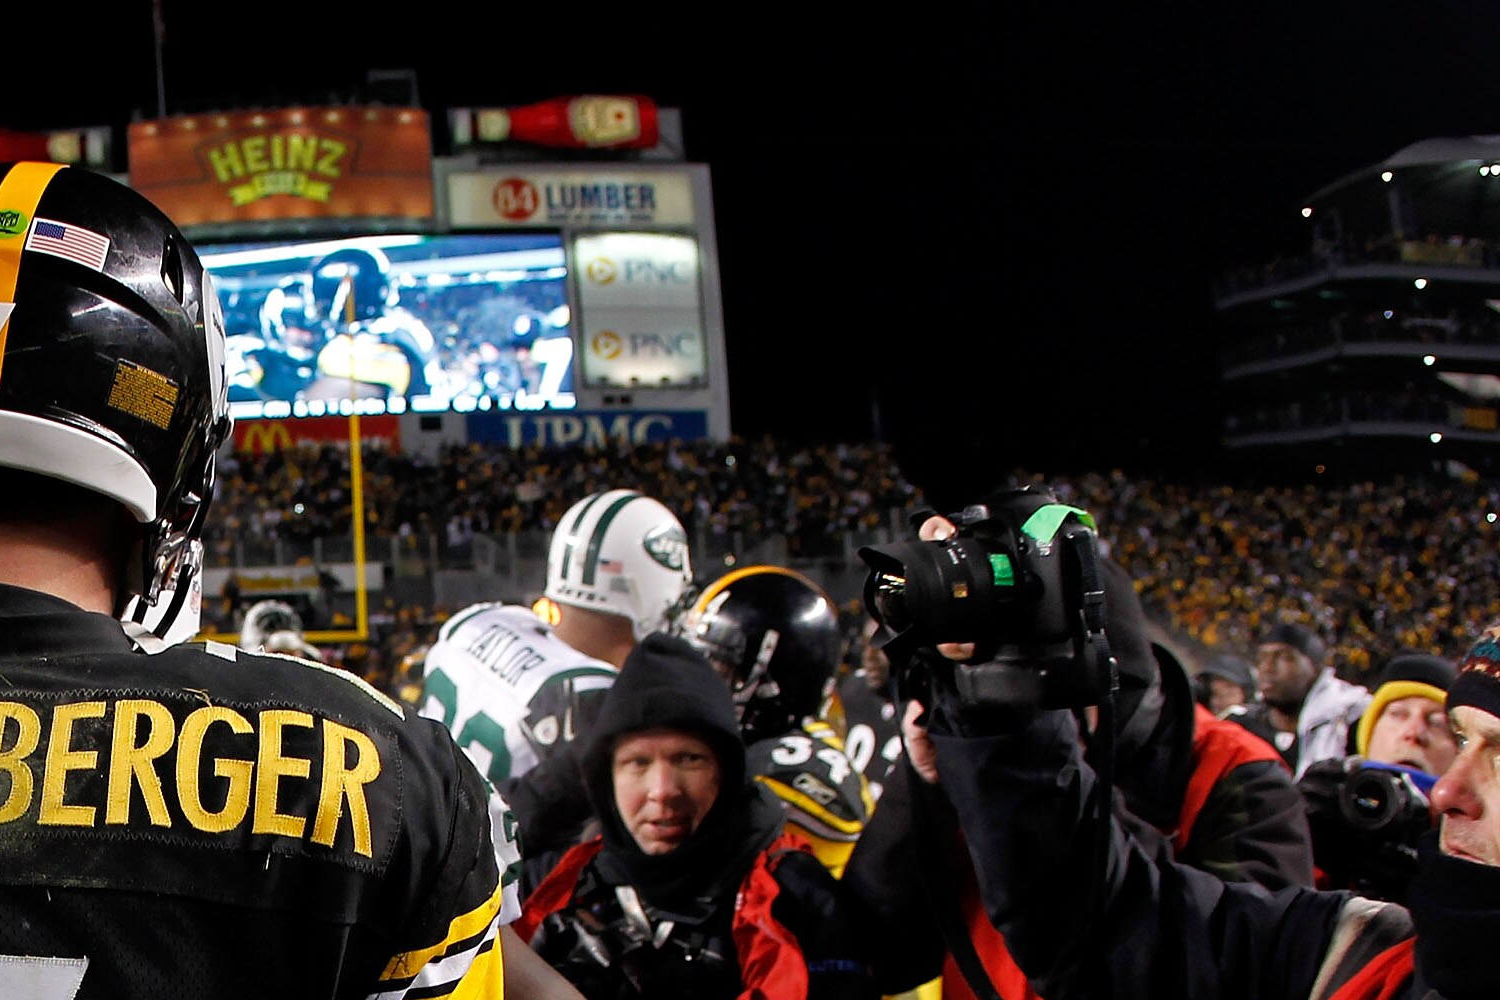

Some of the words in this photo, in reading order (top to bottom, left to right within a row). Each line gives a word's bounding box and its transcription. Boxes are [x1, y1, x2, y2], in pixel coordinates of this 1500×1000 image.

[208, 133, 348, 183] HEINZ
[545, 182, 656, 210] LUMBER
[624, 259, 693, 284] PNC
[629, 332, 698, 357] PNC
[136, 365, 168, 384] WARNING
[503, 413, 674, 449] UPMC
[467, 623, 546, 687] TAYLOR
